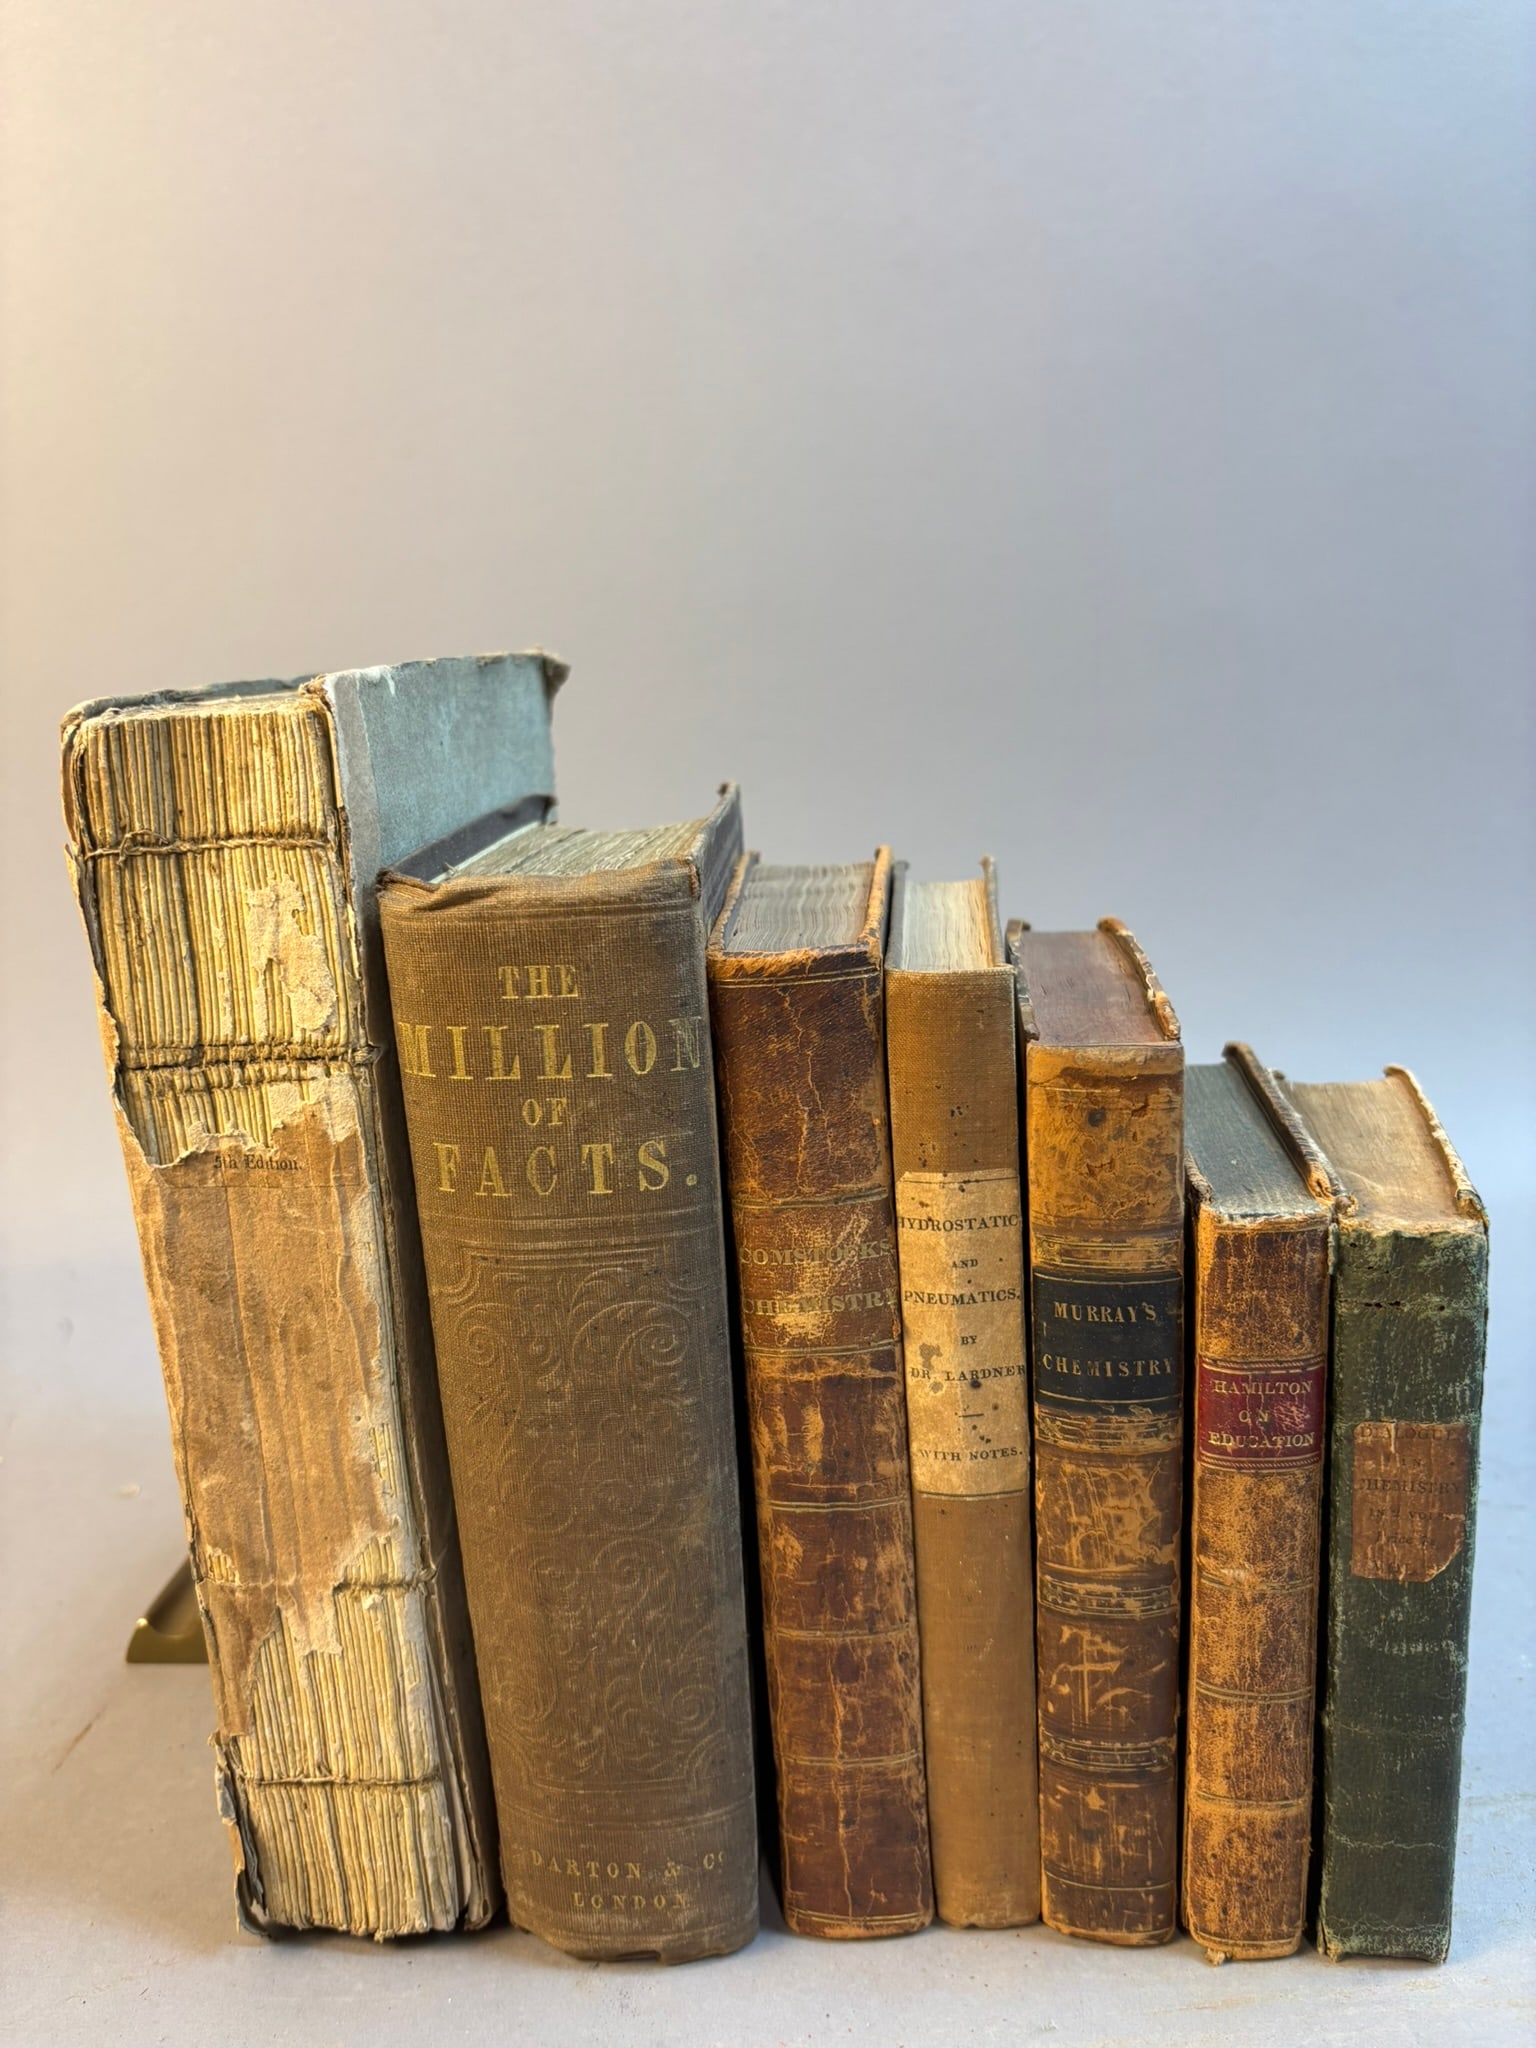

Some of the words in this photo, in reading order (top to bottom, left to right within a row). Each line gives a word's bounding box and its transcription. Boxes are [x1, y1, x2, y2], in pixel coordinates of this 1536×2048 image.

[499, 965, 579, 999] THE
[399, 1016, 702, 1080] MILLION
[521, 1098, 568, 1126] OF
[214, 1155, 238, 1170] 5th
[244, 1154, 303, 1171] Edition.
[433, 1140, 698, 1197] FACTS.
[951, 1258, 979, 1269] AND
[904, 1288, 1020, 1306] PNEUMATICS.
[1054, 1301, 1157, 1323] MURRAY'S
[961, 1335, 977, 1346] BY
[944, 1364, 1026, 1382] LARDNER
[1042, 1353, 1173, 1377] CHEMISTRY
[1211, 1380, 1313, 1395] HAMILTON
[1238, 1410, 1269, 1423] ON
[1208, 1431, 1315, 1449] EDUCATION
[919, 1450, 961, 1461] WITH
[969, 1446, 1023, 1461] NOTES.
[532, 1850, 642, 1879] DARTON
[664, 1861, 682, 1879] &
